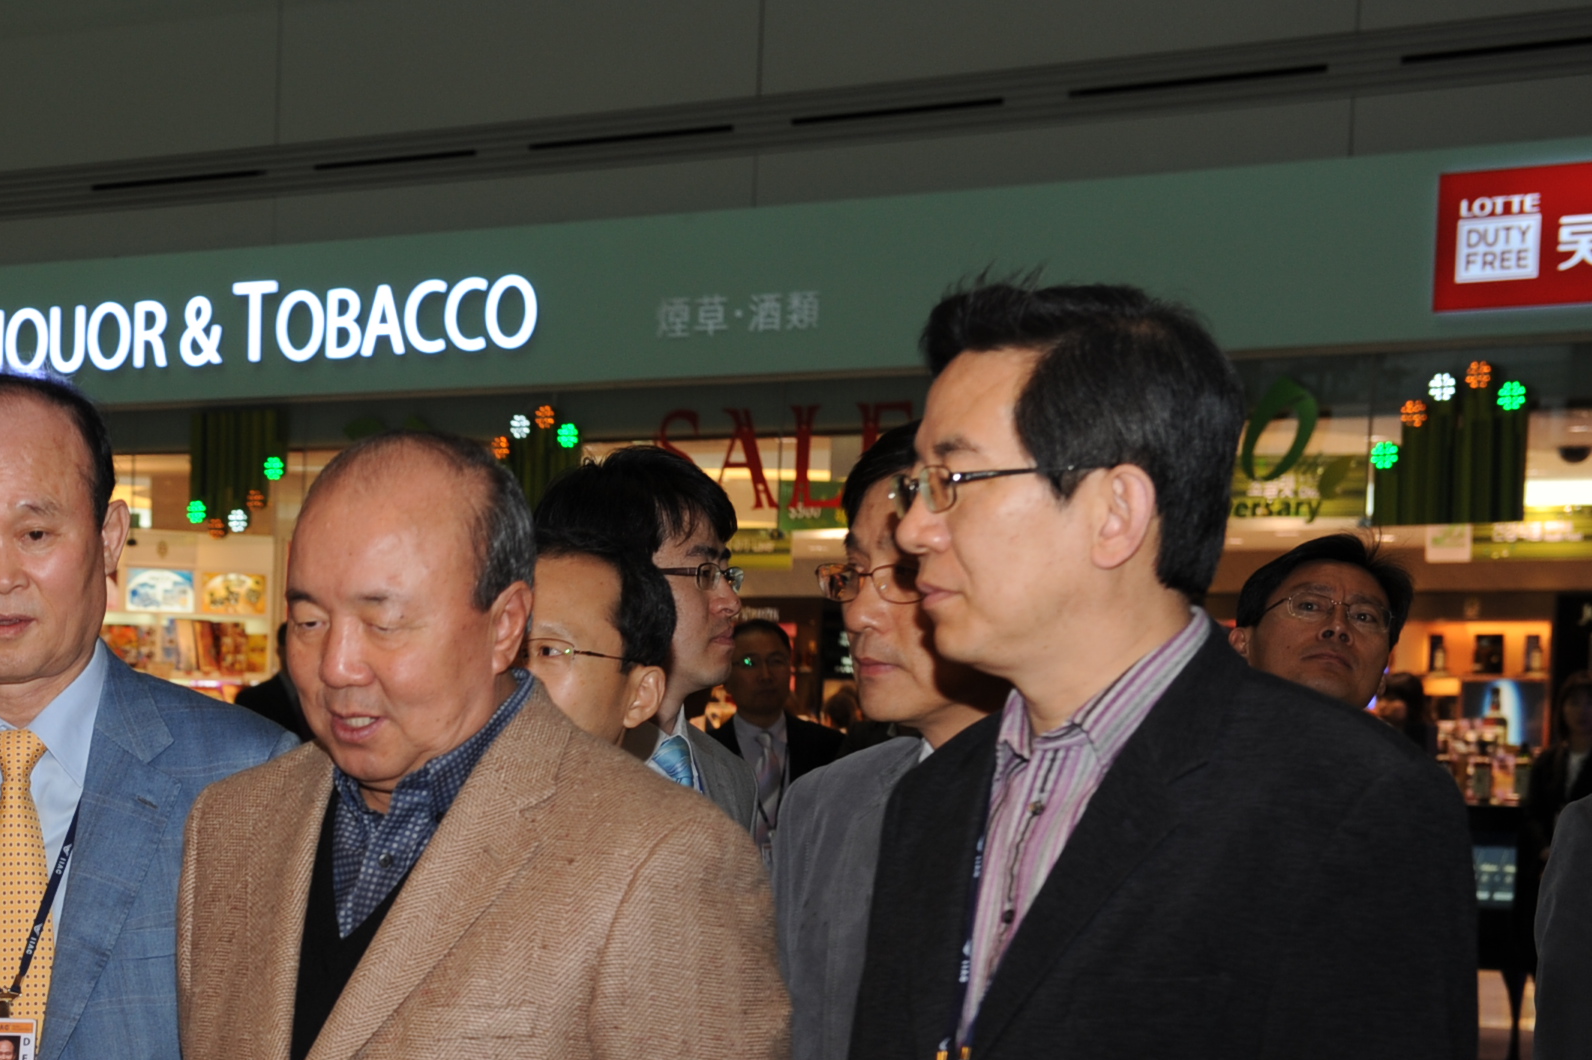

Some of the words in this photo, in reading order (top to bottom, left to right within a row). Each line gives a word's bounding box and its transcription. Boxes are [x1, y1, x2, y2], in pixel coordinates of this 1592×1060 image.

[1459, 192, 1541, 218] LOTTE
[1466, 224, 1532, 249] DUTY
[1465, 249, 1529, 272] FREE
[179, 295, 223, 366] &
[232, 273, 539, 363] TOBACCO
[55, 857, 67, 876] IIAC
[26, 937, 37, 955] IIAC
[23, 1038, 31, 1046] D
